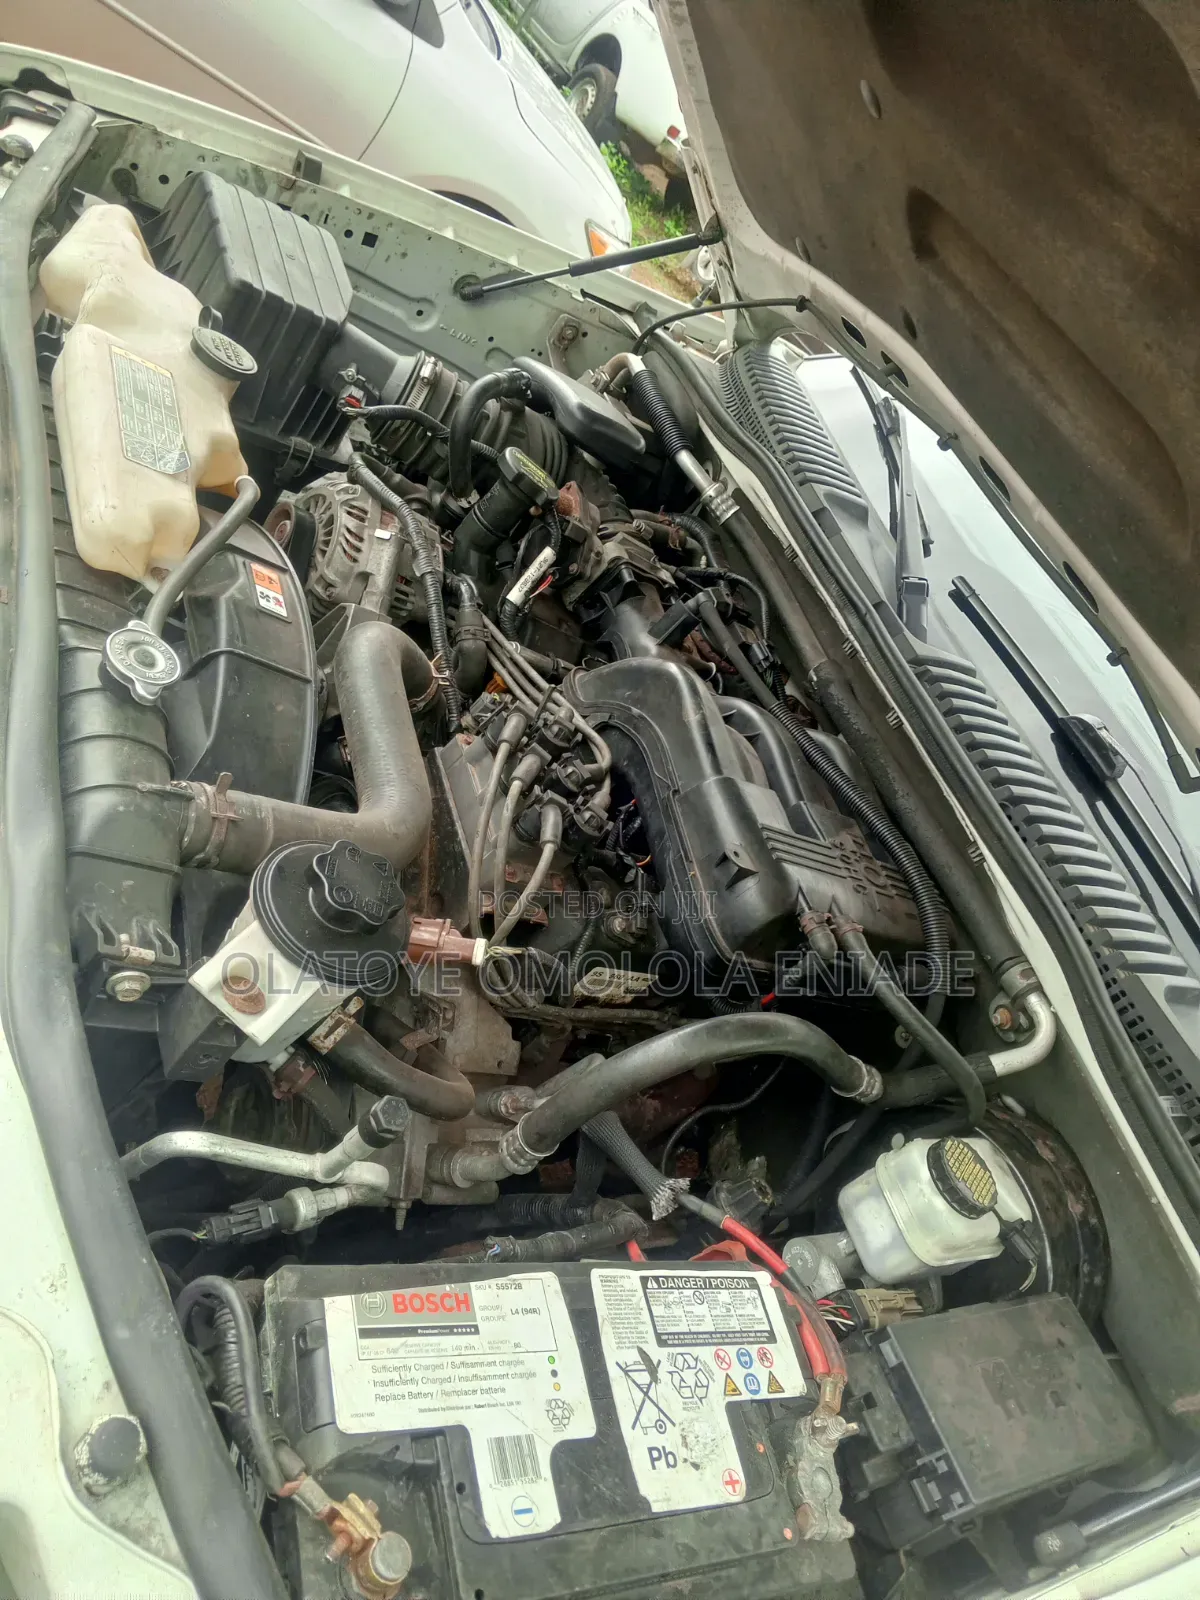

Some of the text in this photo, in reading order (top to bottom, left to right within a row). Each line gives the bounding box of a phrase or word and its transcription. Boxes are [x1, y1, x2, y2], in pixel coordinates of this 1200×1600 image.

[658, 1278, 705, 1289] DANGER
[711, 1278, 750, 1289] POISON
[392, 1292, 471, 1314] BOSCH
[510, 1306, 541, 1316] L4 (94R)
[371, 1363, 412, 1374] Sufficiently
[414, 1361, 444, 1372] Charged
[450, 1359, 498, 1370] Suffisamment
[373, 1376, 419, 1388] Insufficiently
[421, 1374, 452, 1385] Charged
[458, 1372, 509, 1384] Insuffisamment
[374, 1393, 406, 1403] Replace
[407, 1390, 434, 1400] Battery
[440, 1387, 478, 1398] Remplacer
[480, 1385, 506, 1395] batterie
[647, 1445, 678, 1471] Pb
